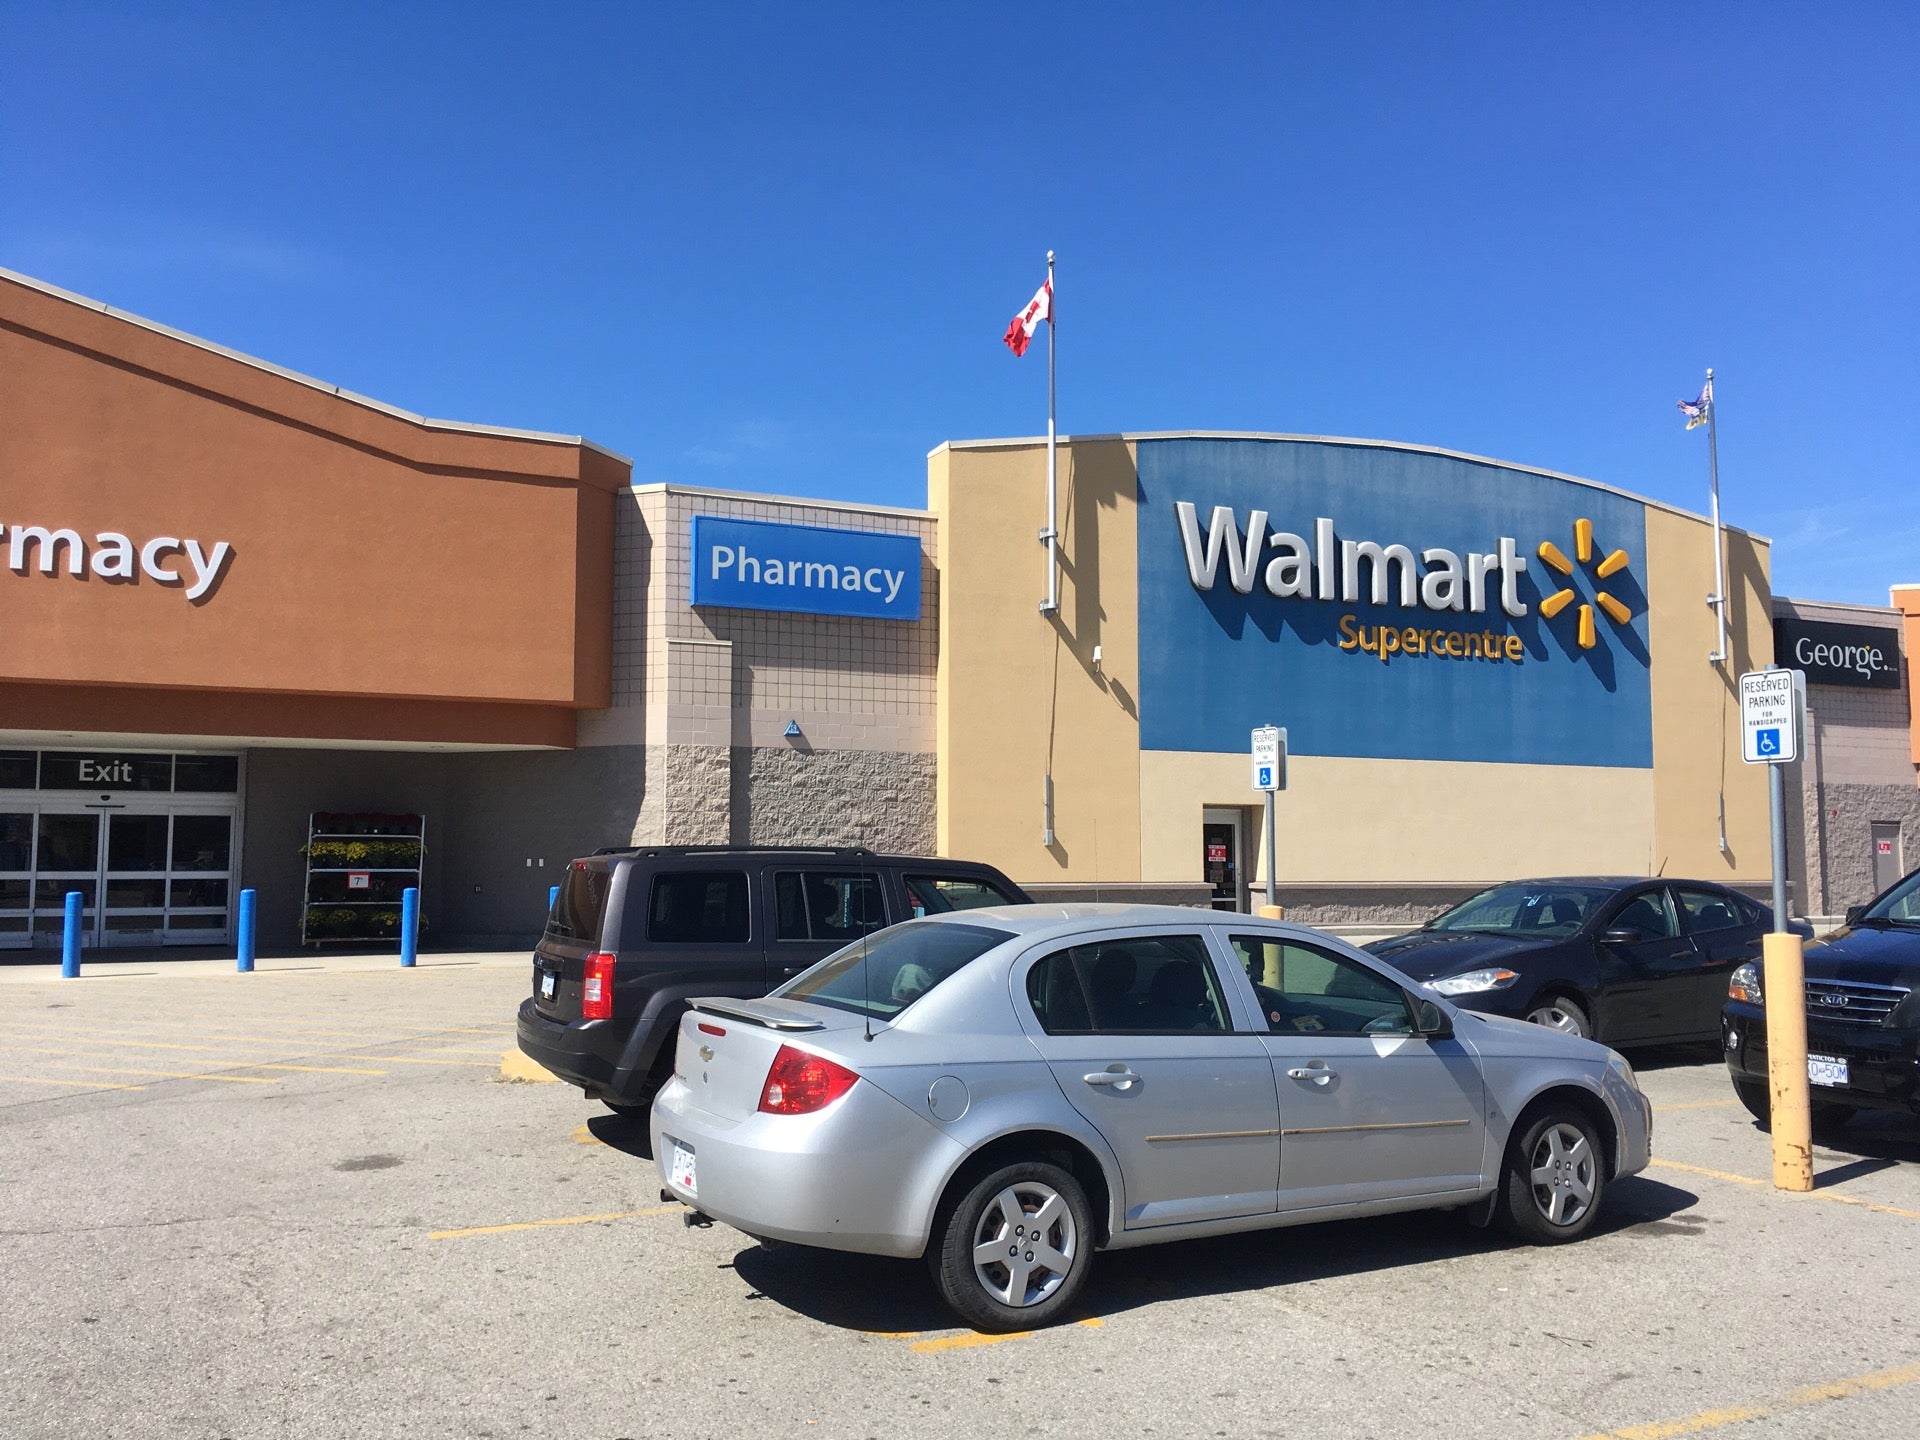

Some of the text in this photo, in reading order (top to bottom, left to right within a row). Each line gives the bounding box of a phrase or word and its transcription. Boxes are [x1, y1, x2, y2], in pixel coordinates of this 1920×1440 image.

[0, 524, 230, 600] macy
[1176, 501, 1528, 618] Walmart
[711, 545, 904, 604] Pharmacy
[1339, 615, 1524, 661] Supercentre
[1744, 678, 1789, 693] RESERVED
[1749, 694, 1786, 708] PARKING
[1748, 717, 1788, 726] HANDICAPPED
[79, 759, 133, 783] Exit
[1826, 995, 1843, 1005] KIA
